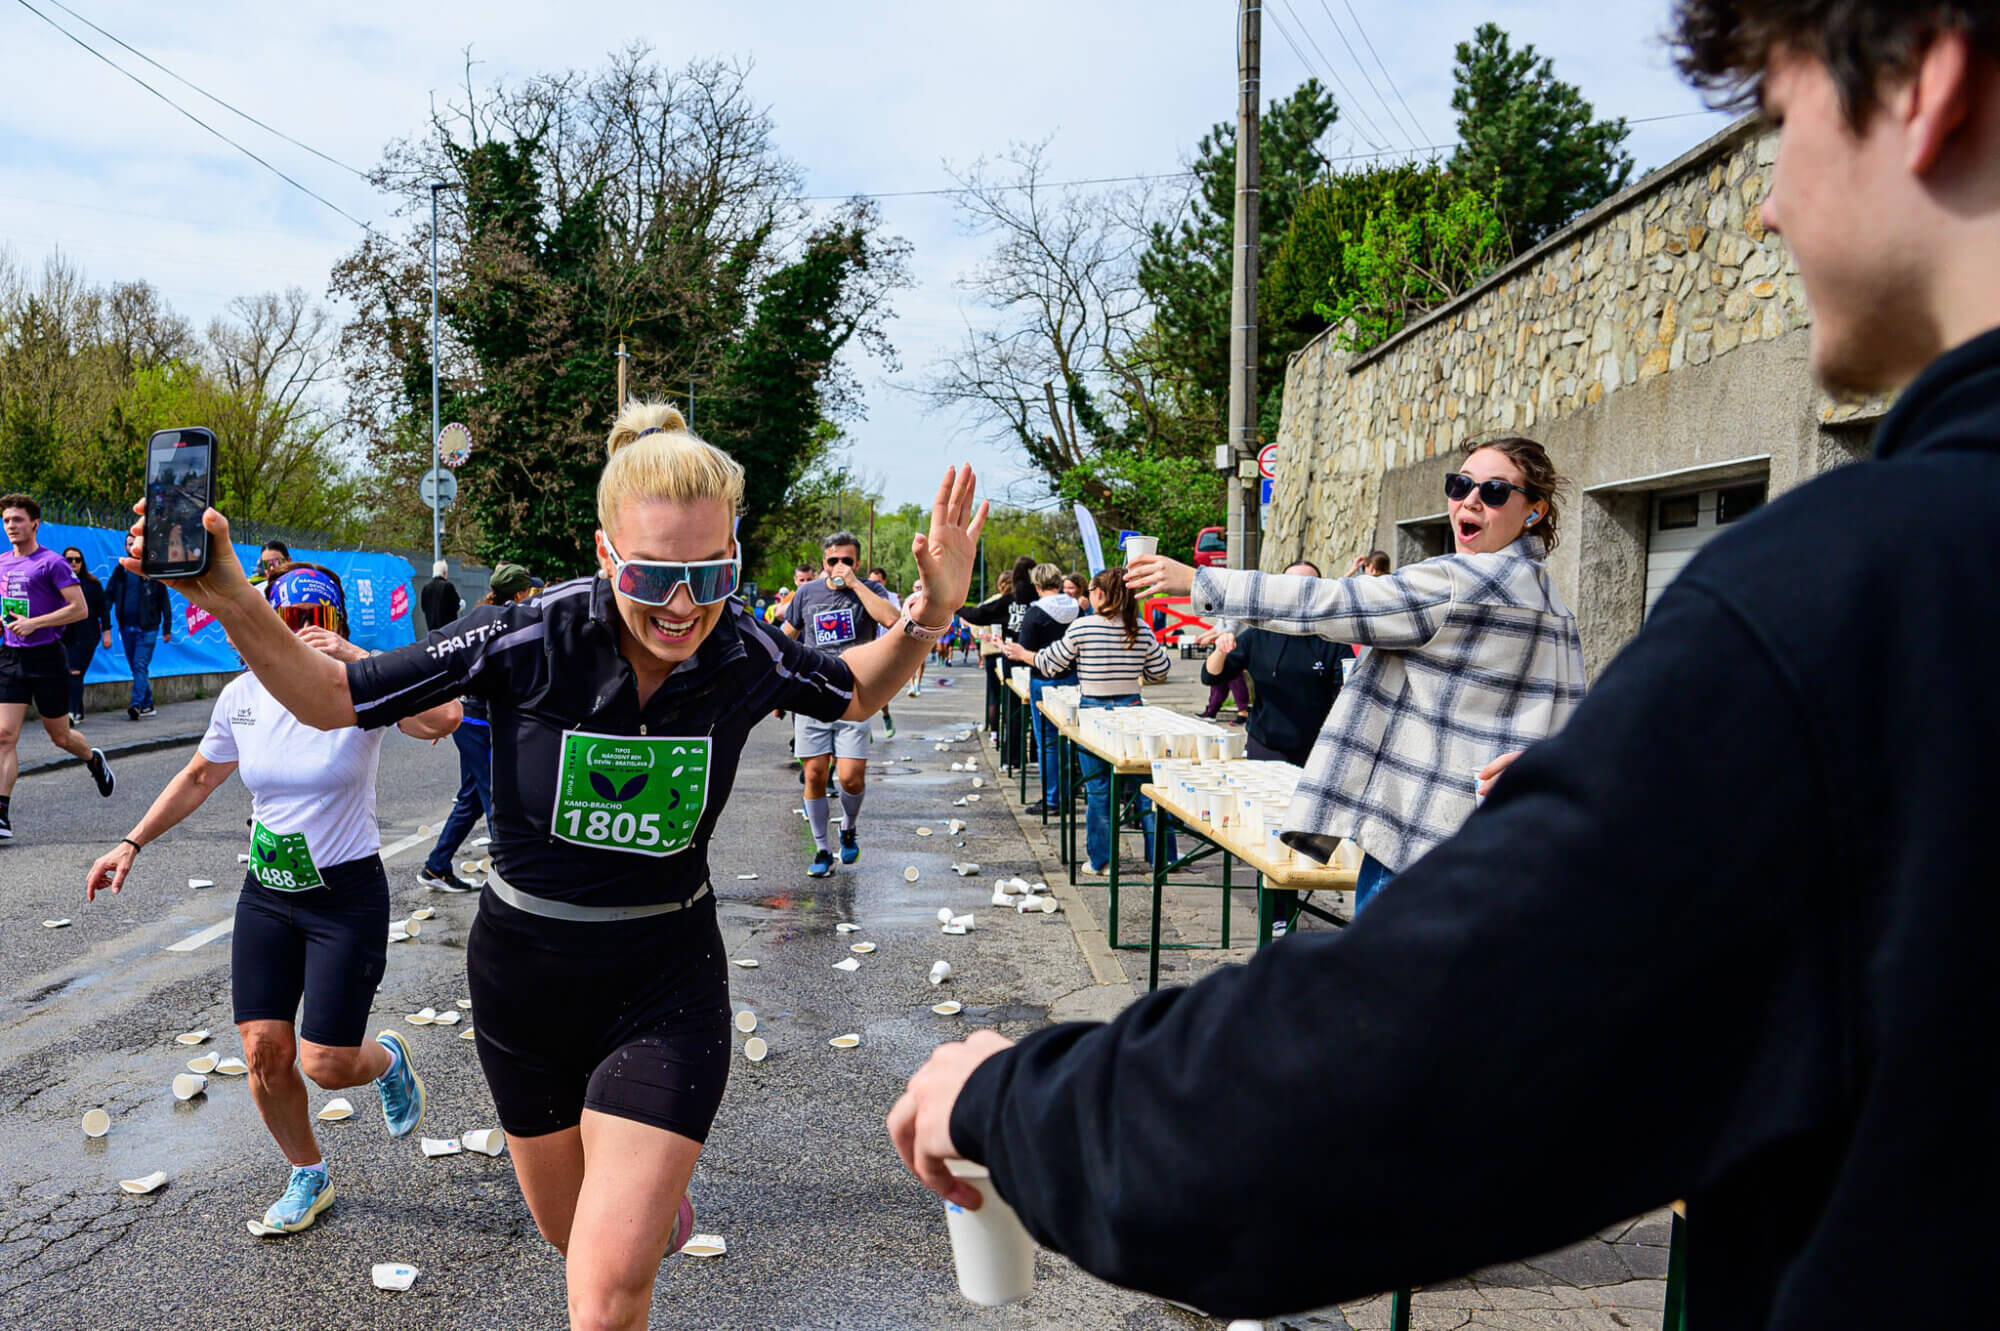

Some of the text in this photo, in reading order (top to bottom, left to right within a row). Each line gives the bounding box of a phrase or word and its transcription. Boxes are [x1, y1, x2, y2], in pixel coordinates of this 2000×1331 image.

[818, 630, 838, 642] 604
[564, 800, 622, 810] KAMO-BRACHO
[563, 809, 661, 846] 1805
[251, 863, 297, 888] 1488
